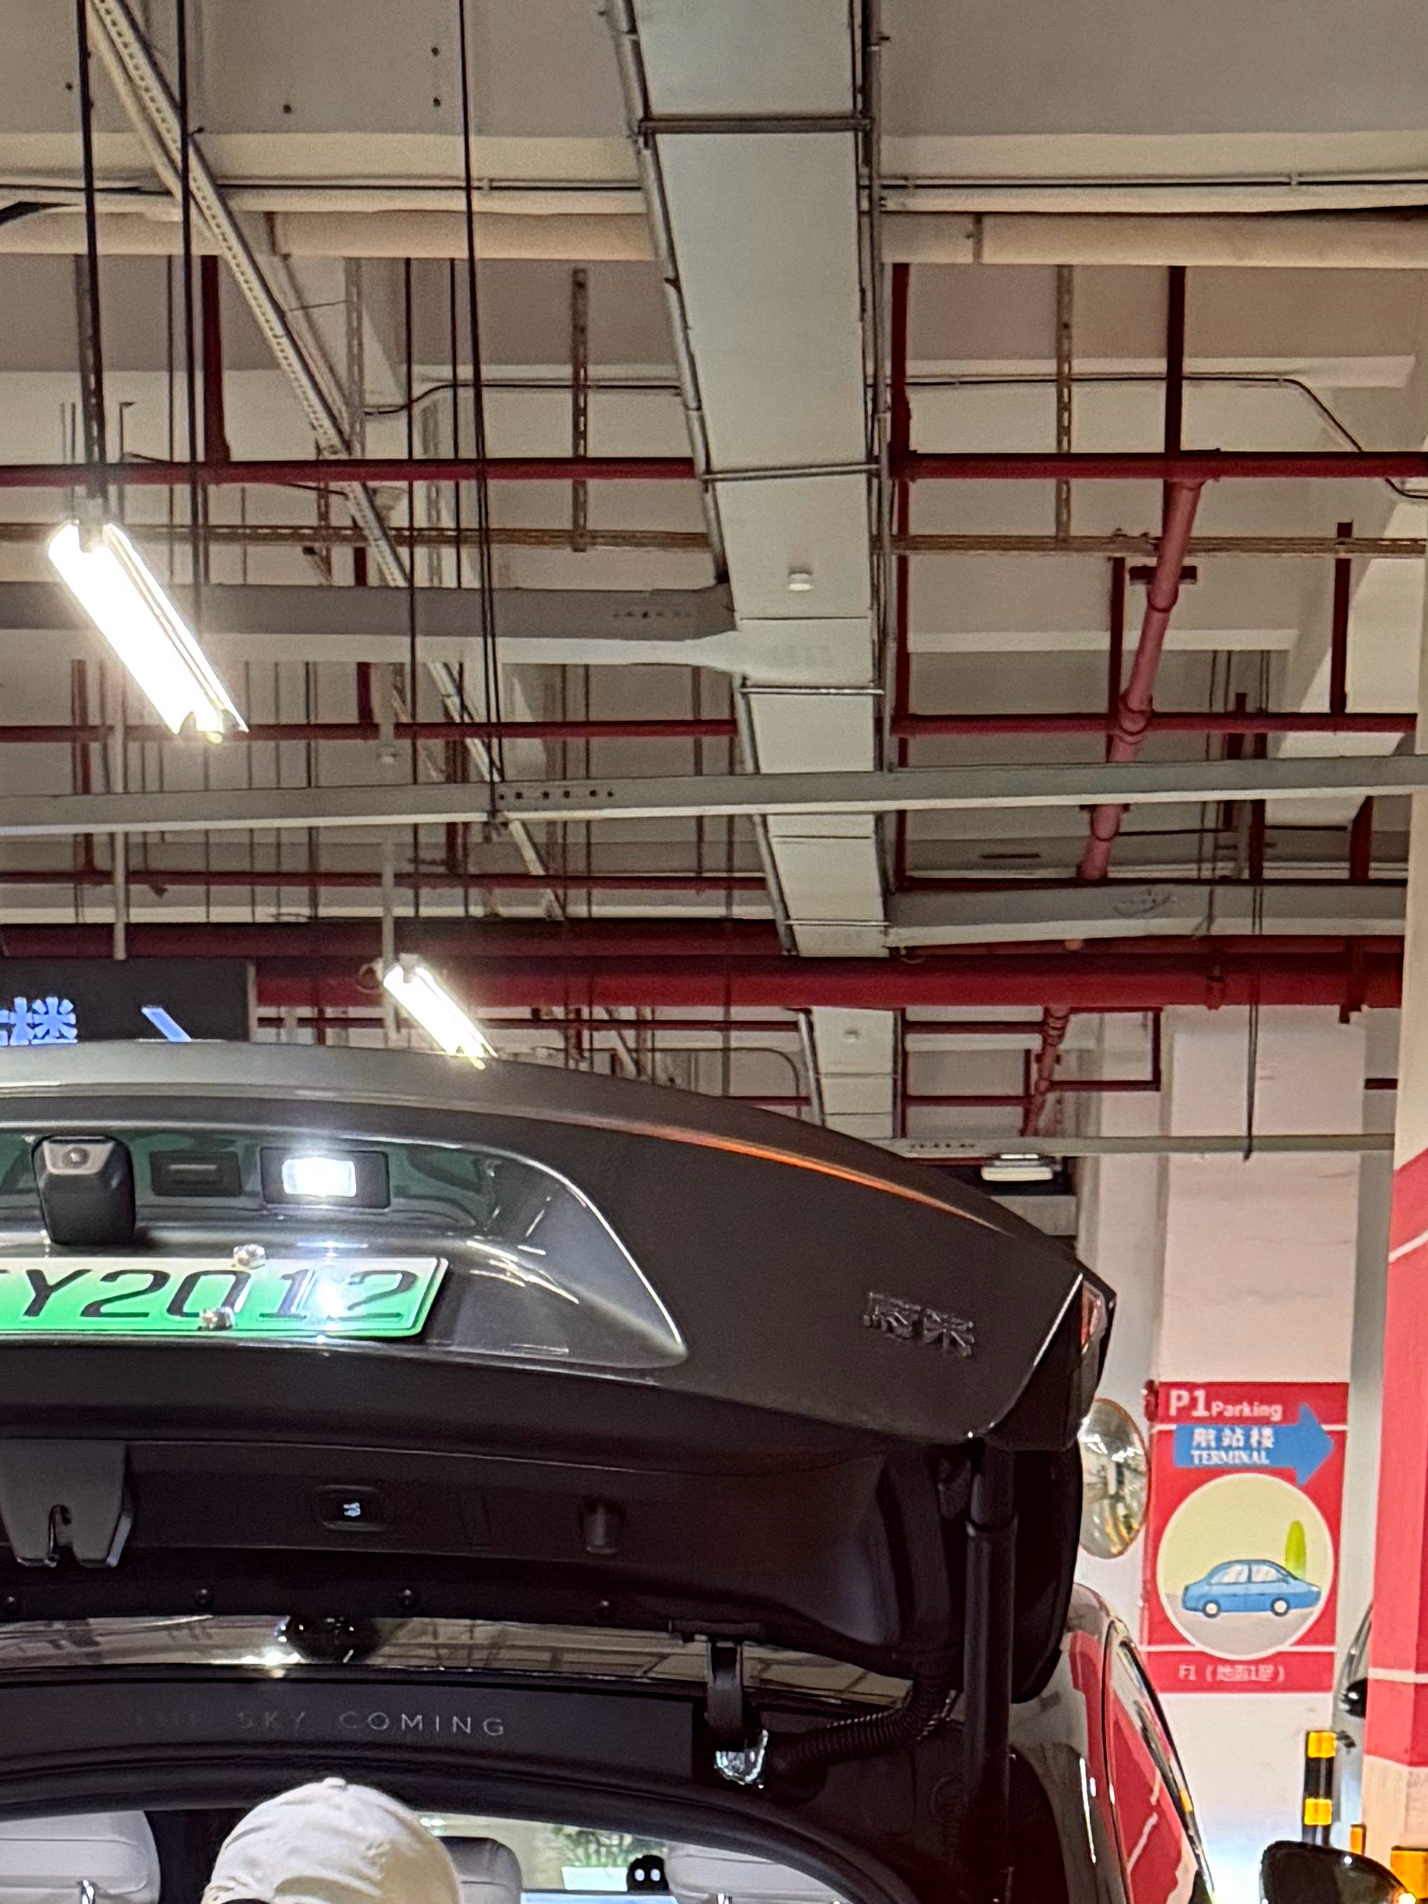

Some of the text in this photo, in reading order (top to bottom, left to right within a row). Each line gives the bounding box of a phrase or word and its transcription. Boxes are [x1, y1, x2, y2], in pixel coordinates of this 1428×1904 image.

[1169, 1388, 1283, 1421] P1 Parking
[1192, 1427, 1274, 1448] 航站楼
[1190, 1450, 1270, 1465] TERMINAL
[338, 1710, 505, 1737] COMING
